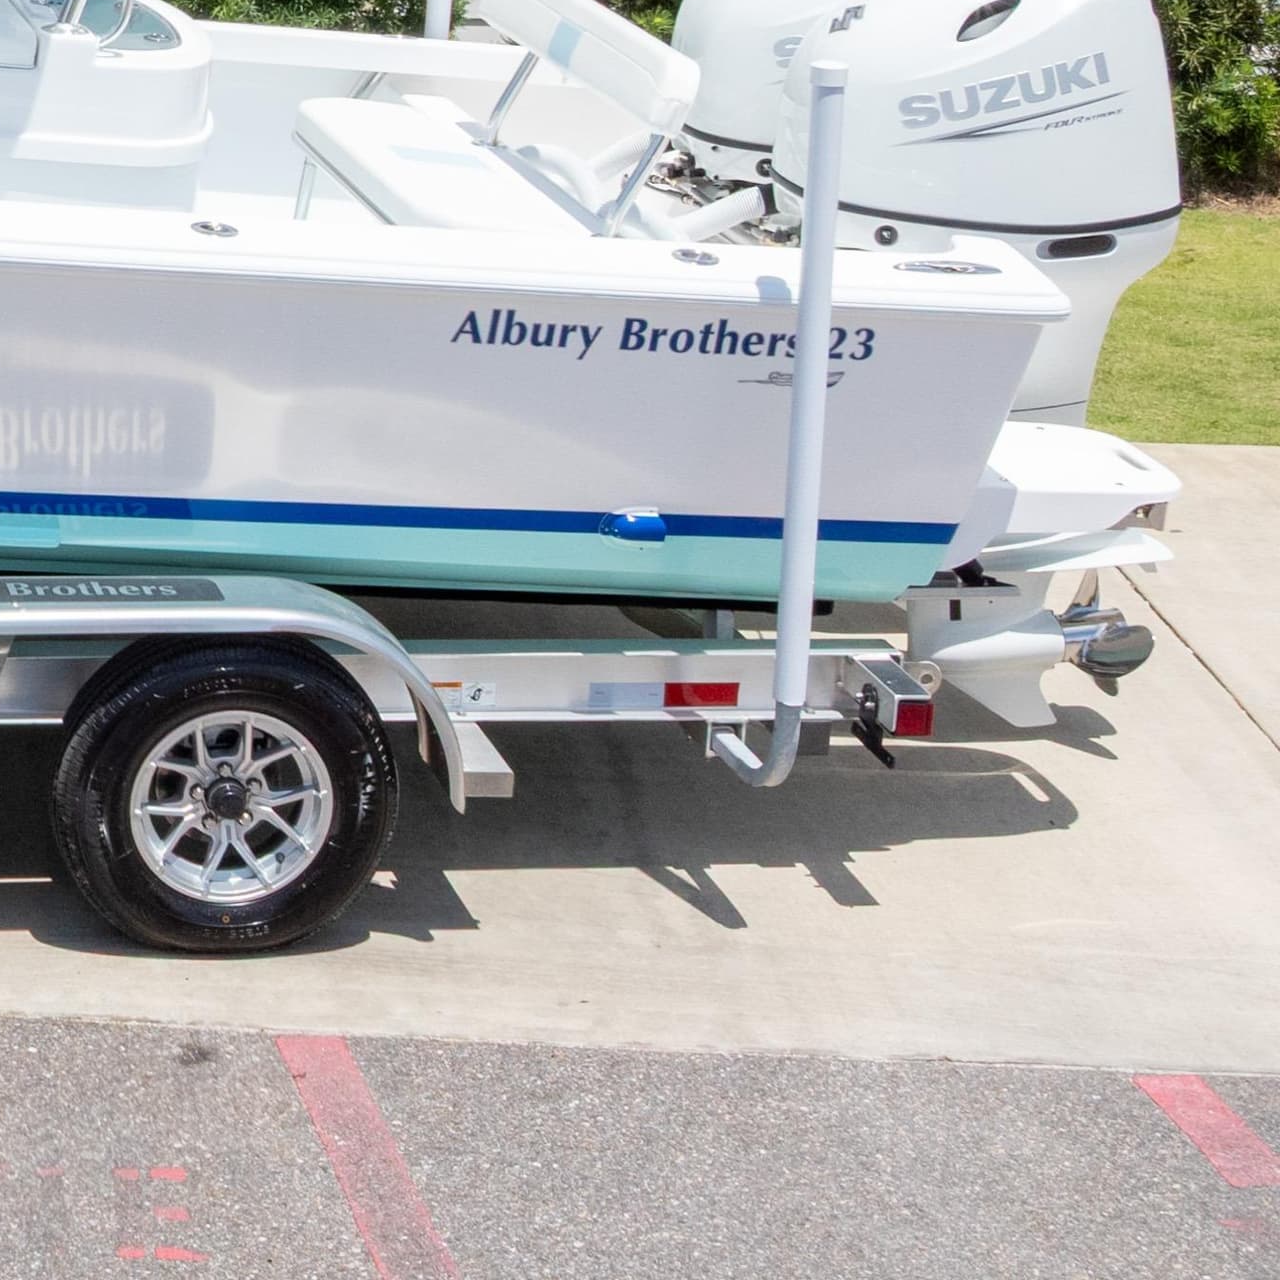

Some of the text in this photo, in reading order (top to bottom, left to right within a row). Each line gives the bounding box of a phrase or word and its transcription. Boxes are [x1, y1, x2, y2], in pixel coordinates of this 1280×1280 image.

[898, 51, 1110, 130] SUZUKI
[450, 308, 603, 360] Albury
[828, 327, 876, 361] 23
[6, 581, 178, 598] Brothers
